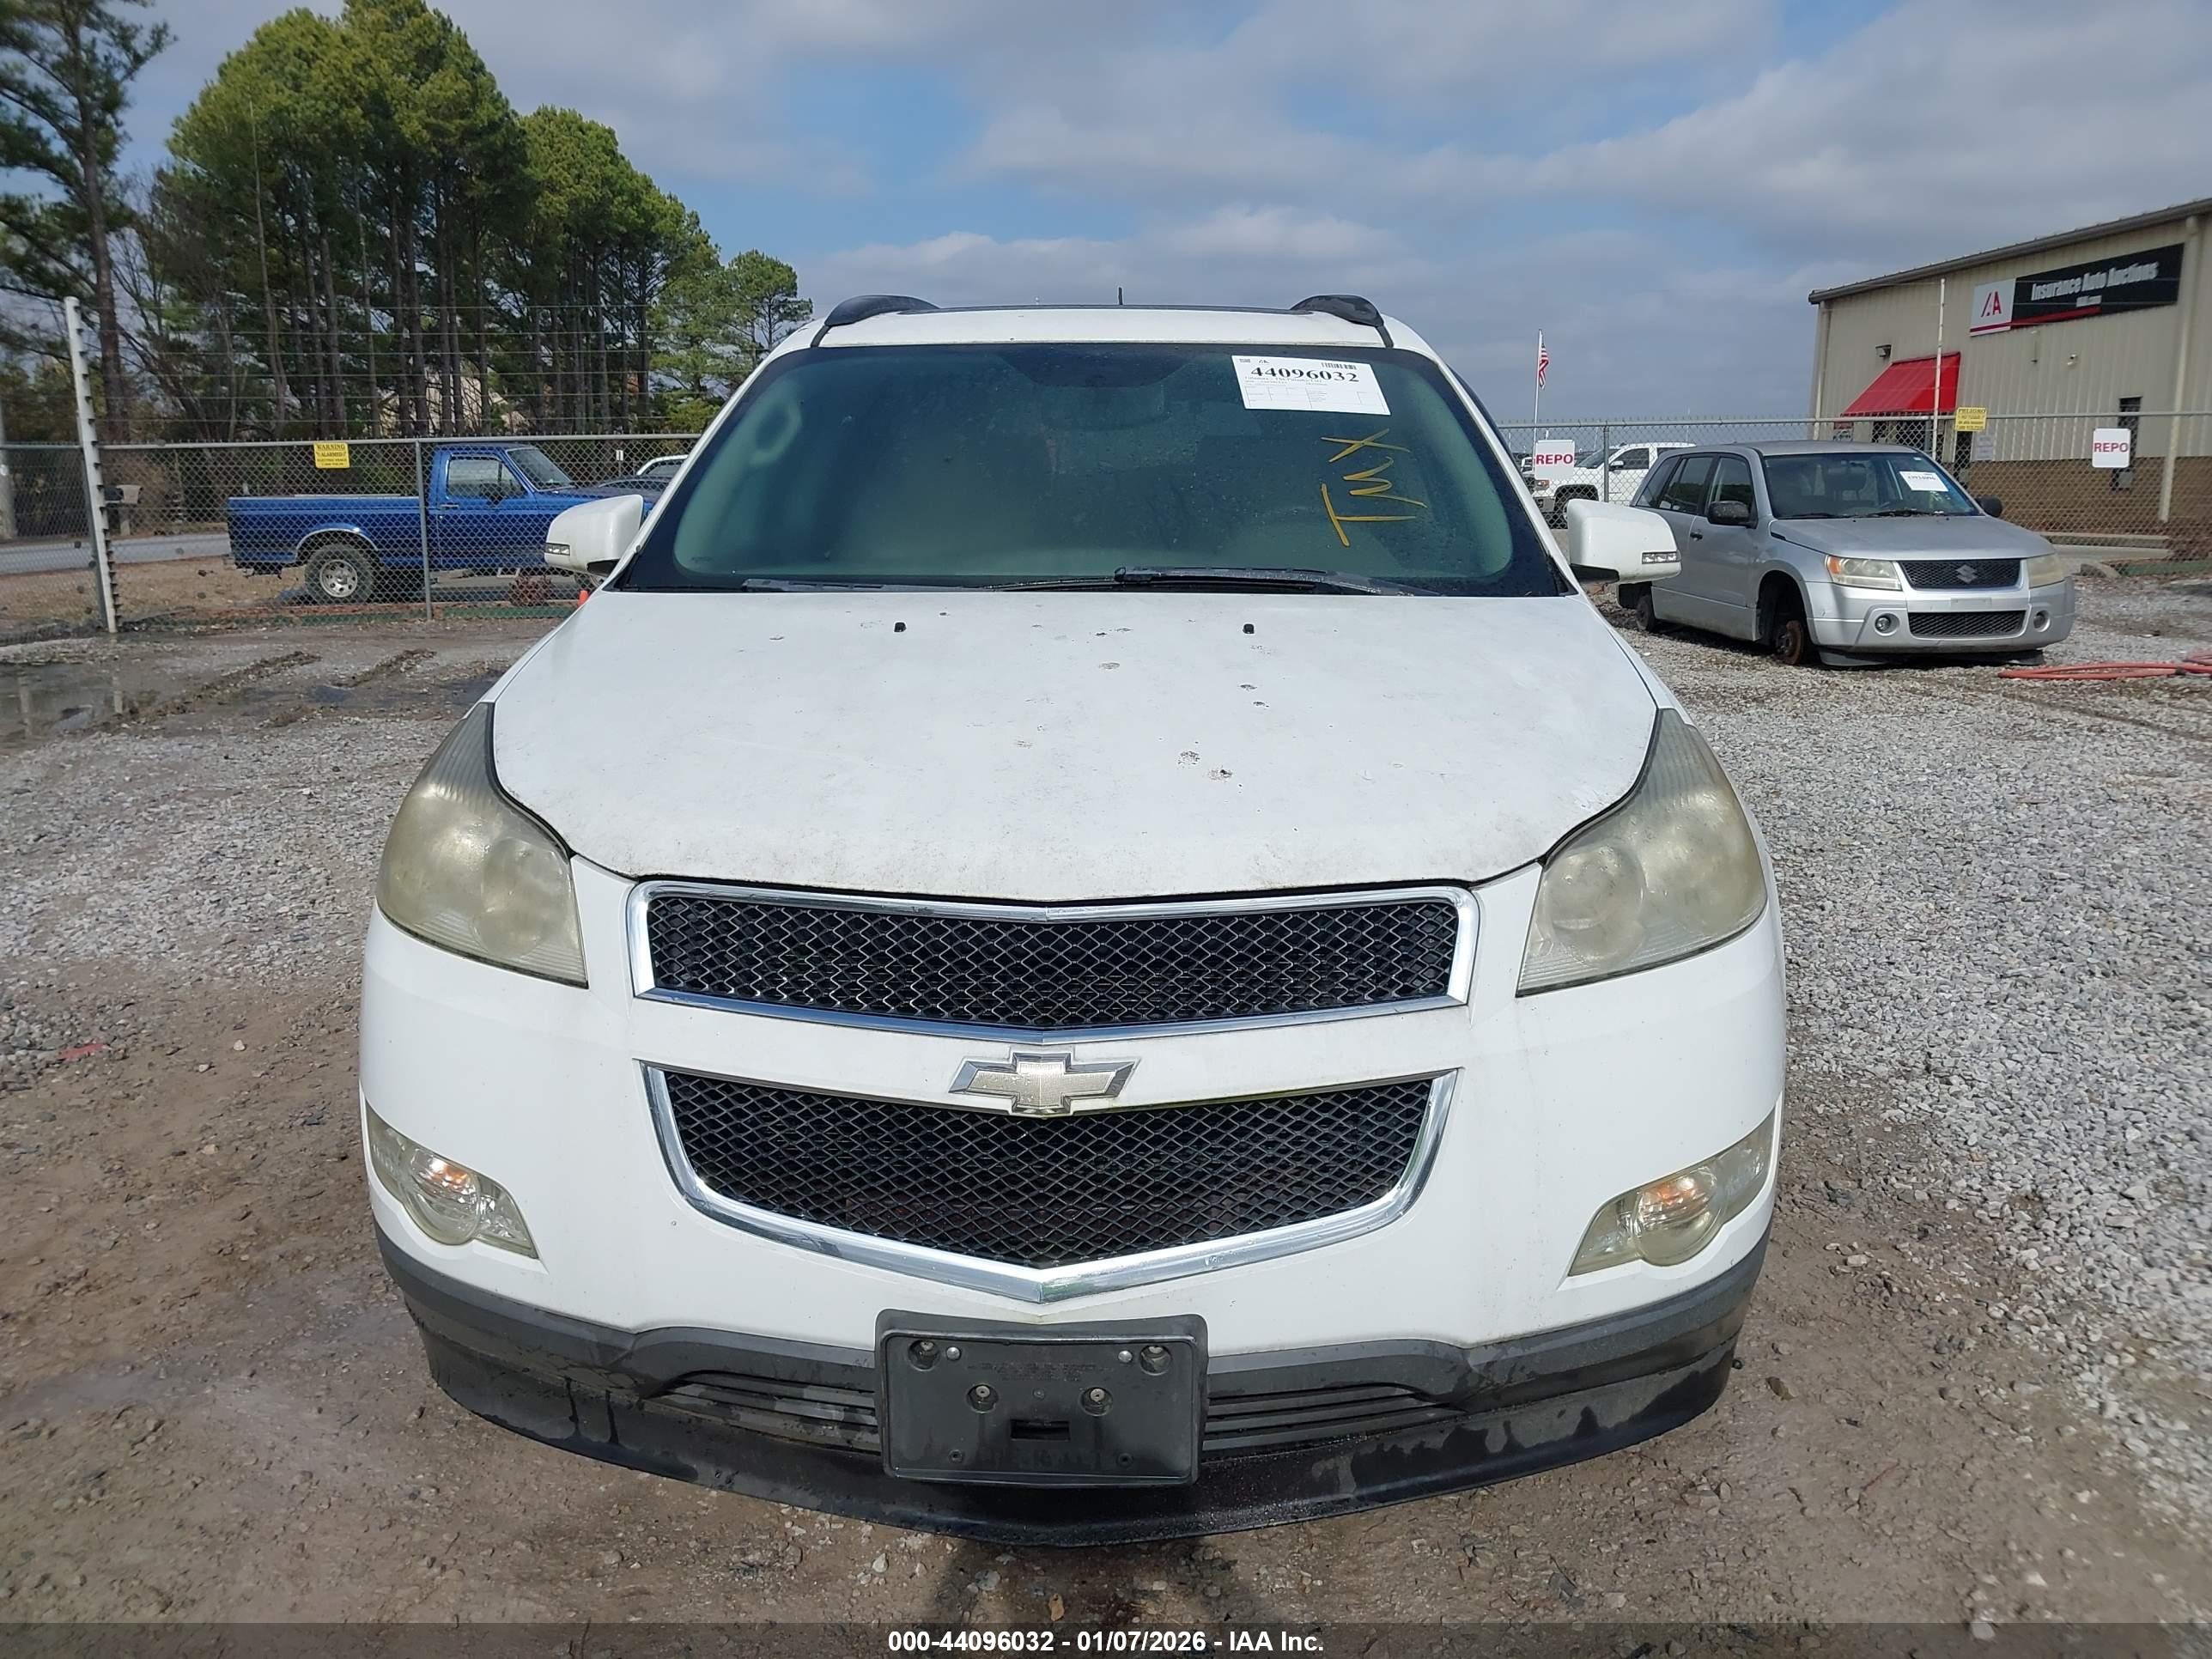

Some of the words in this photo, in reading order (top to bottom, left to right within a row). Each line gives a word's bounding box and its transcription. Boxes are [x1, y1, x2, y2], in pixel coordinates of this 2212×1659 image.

[2031, 277, 2081, 301] Insurance
[2081, 271, 2107, 292] Auto
[2106, 261, 2160, 288] Auctions
[1250, 367, 1359, 382] 44096032
[2094, 441, 2130, 453] REPO
[1535, 453, 1574, 465] REPO
